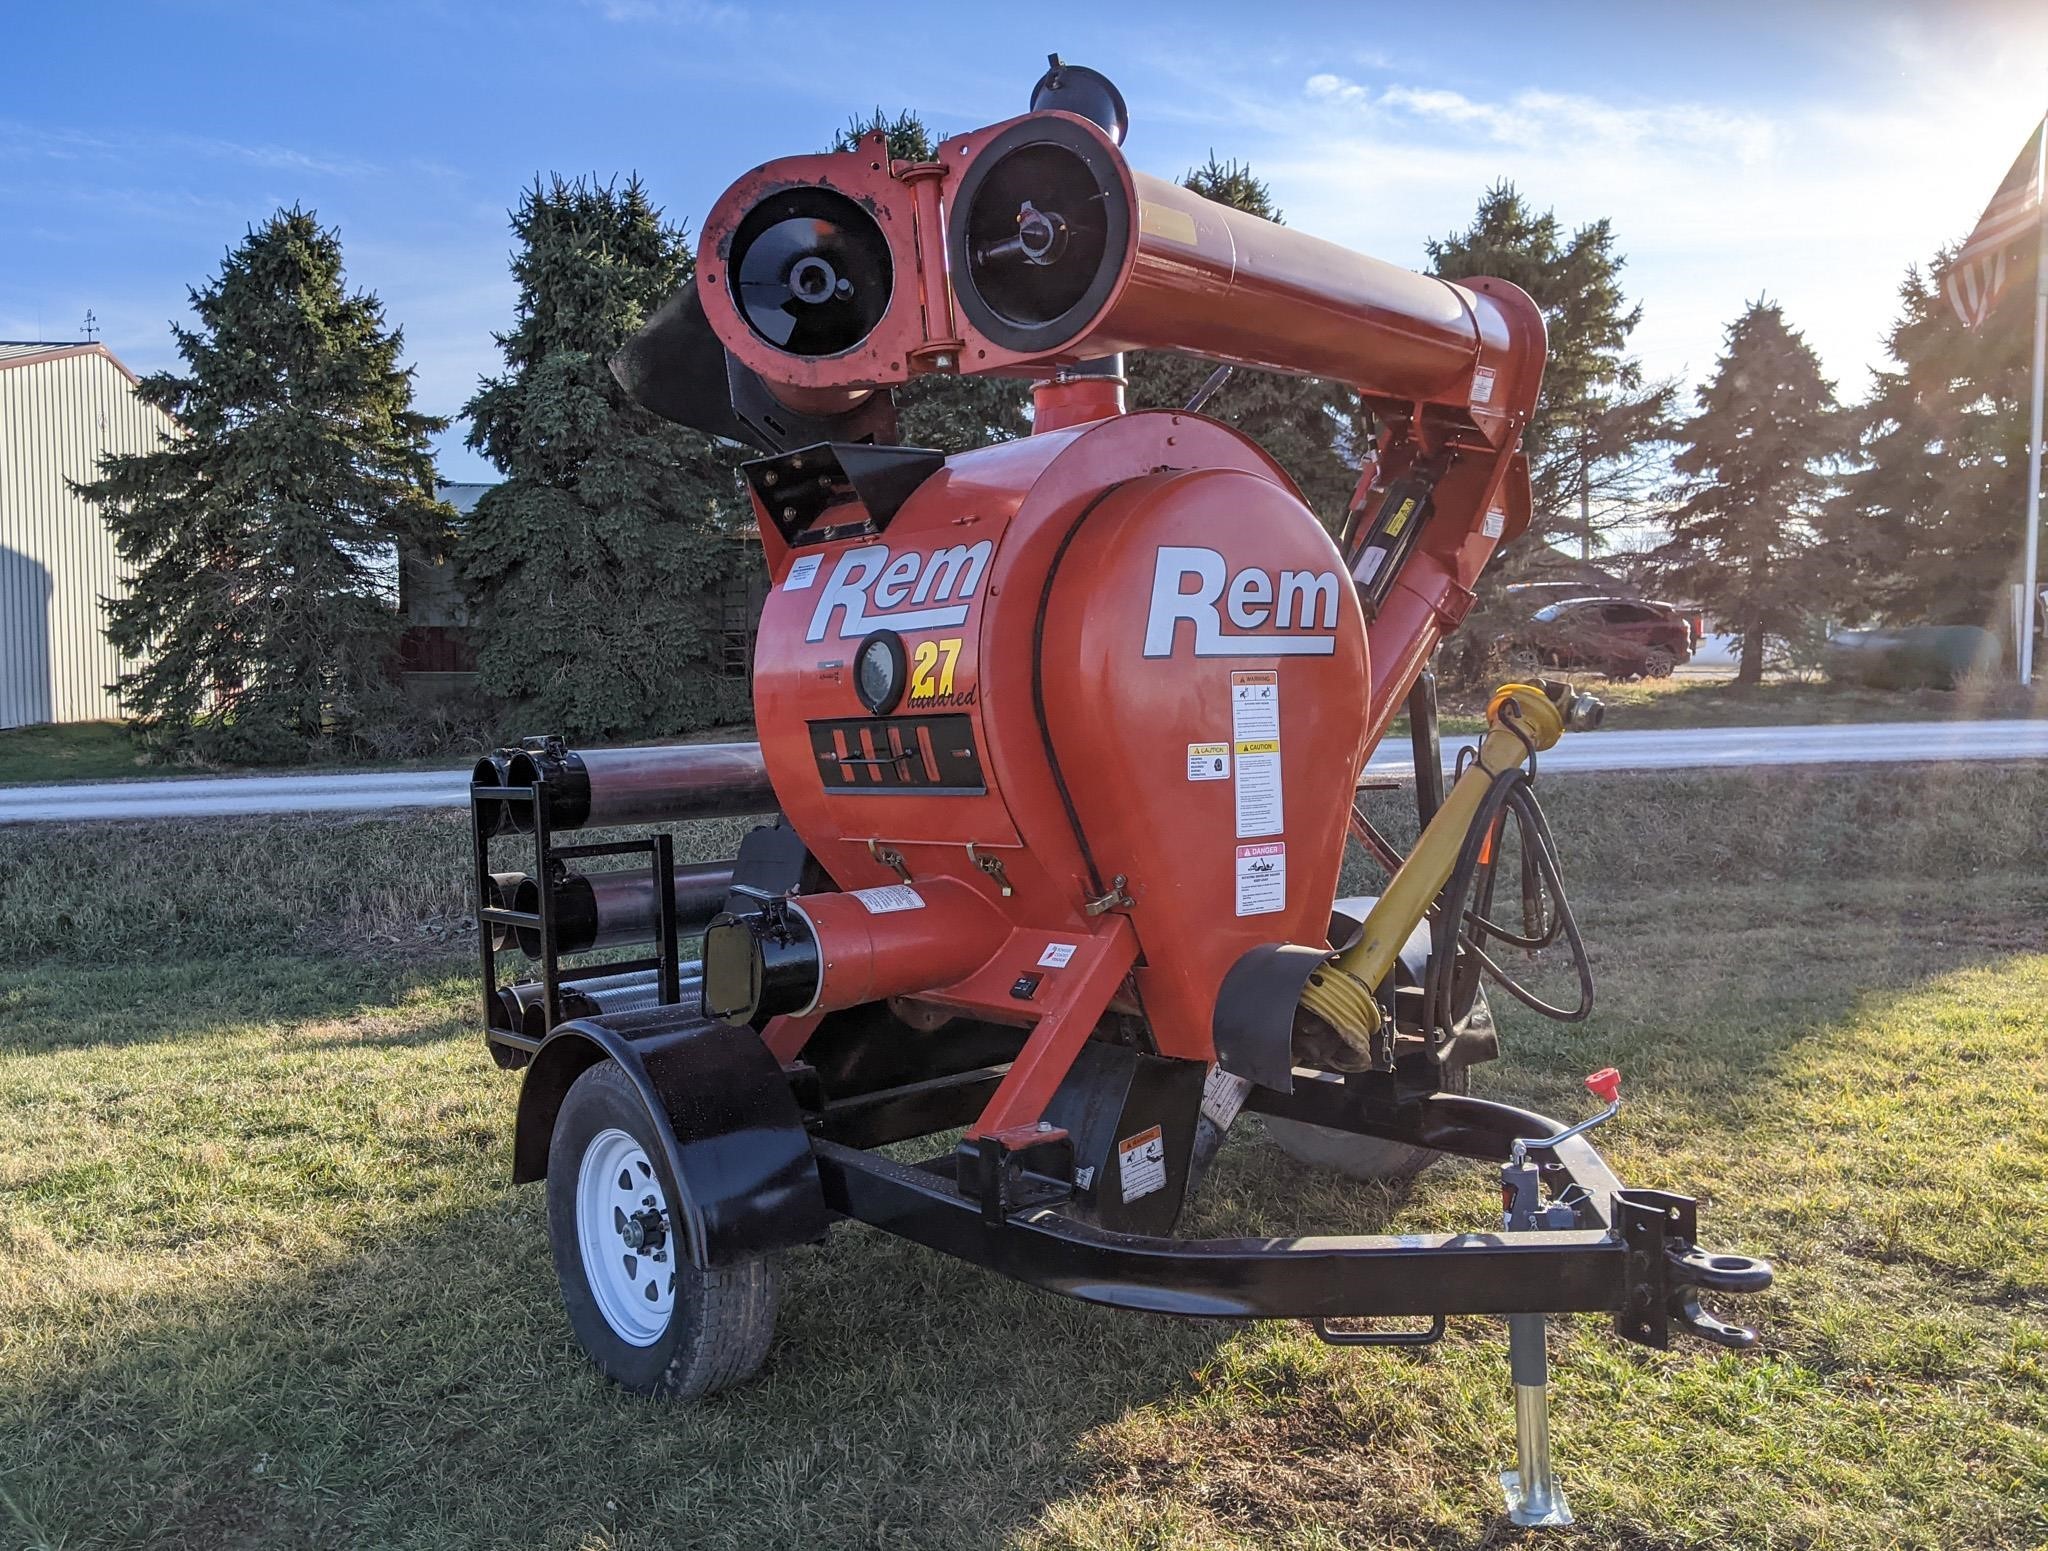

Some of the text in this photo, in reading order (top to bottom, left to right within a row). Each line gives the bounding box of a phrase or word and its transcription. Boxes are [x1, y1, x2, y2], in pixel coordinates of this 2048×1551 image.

[806, 541, 994, 643] Rem
[1142, 545, 1340, 657] Rem
[911, 638, 963, 699] 27
[907, 684, 977, 709] hundred
[1249, 743, 1272, 751] CAUTION
[1252, 846, 1278, 855] DANGER
